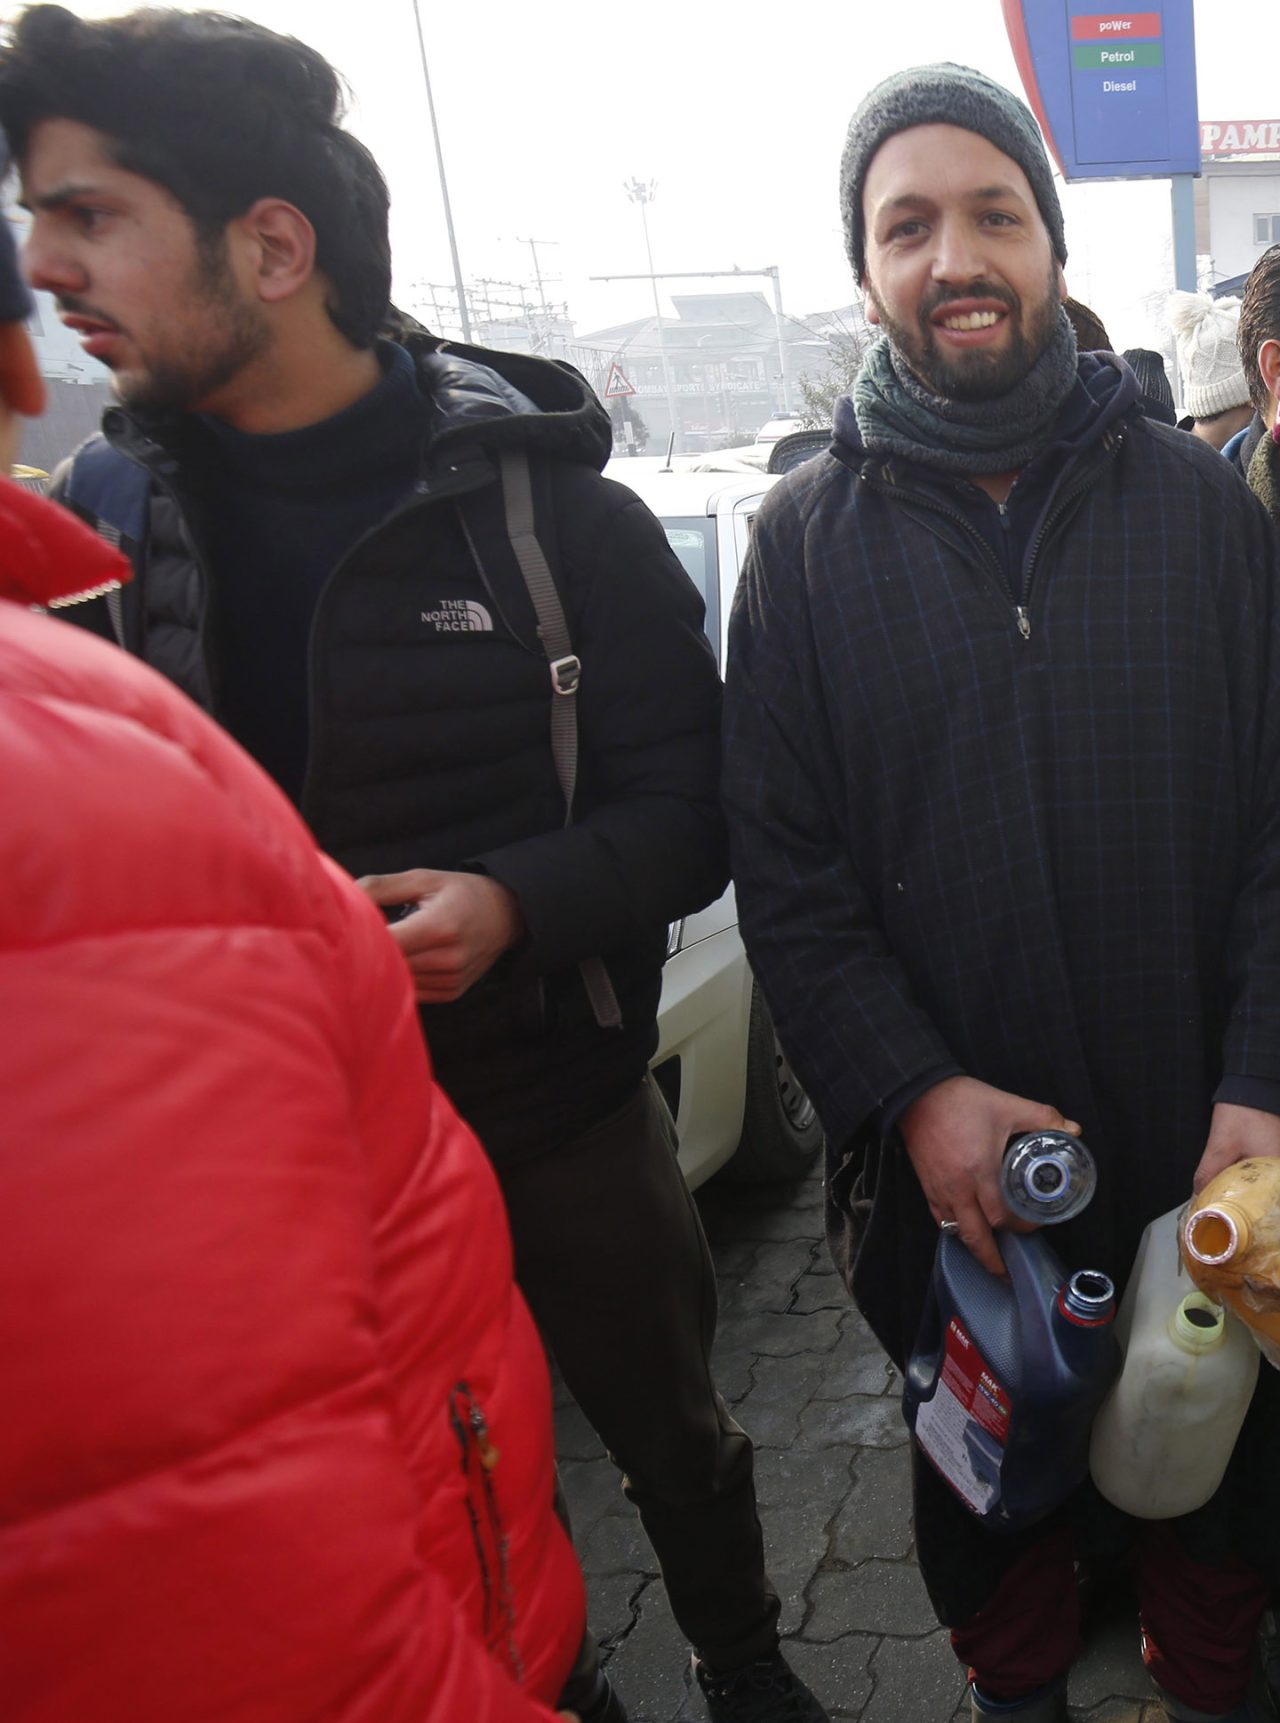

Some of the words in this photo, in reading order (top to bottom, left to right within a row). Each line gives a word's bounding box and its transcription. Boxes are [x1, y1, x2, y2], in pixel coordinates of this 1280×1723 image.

[1100, 50, 1135, 63] Petrol
[1102, 80, 1136, 92] Diesel
[440, 600, 466, 610] THE
[421, 610, 467, 623] NORTH
[435, 621, 469, 632] FACE
[980, 1371, 1000, 1393] MAK
